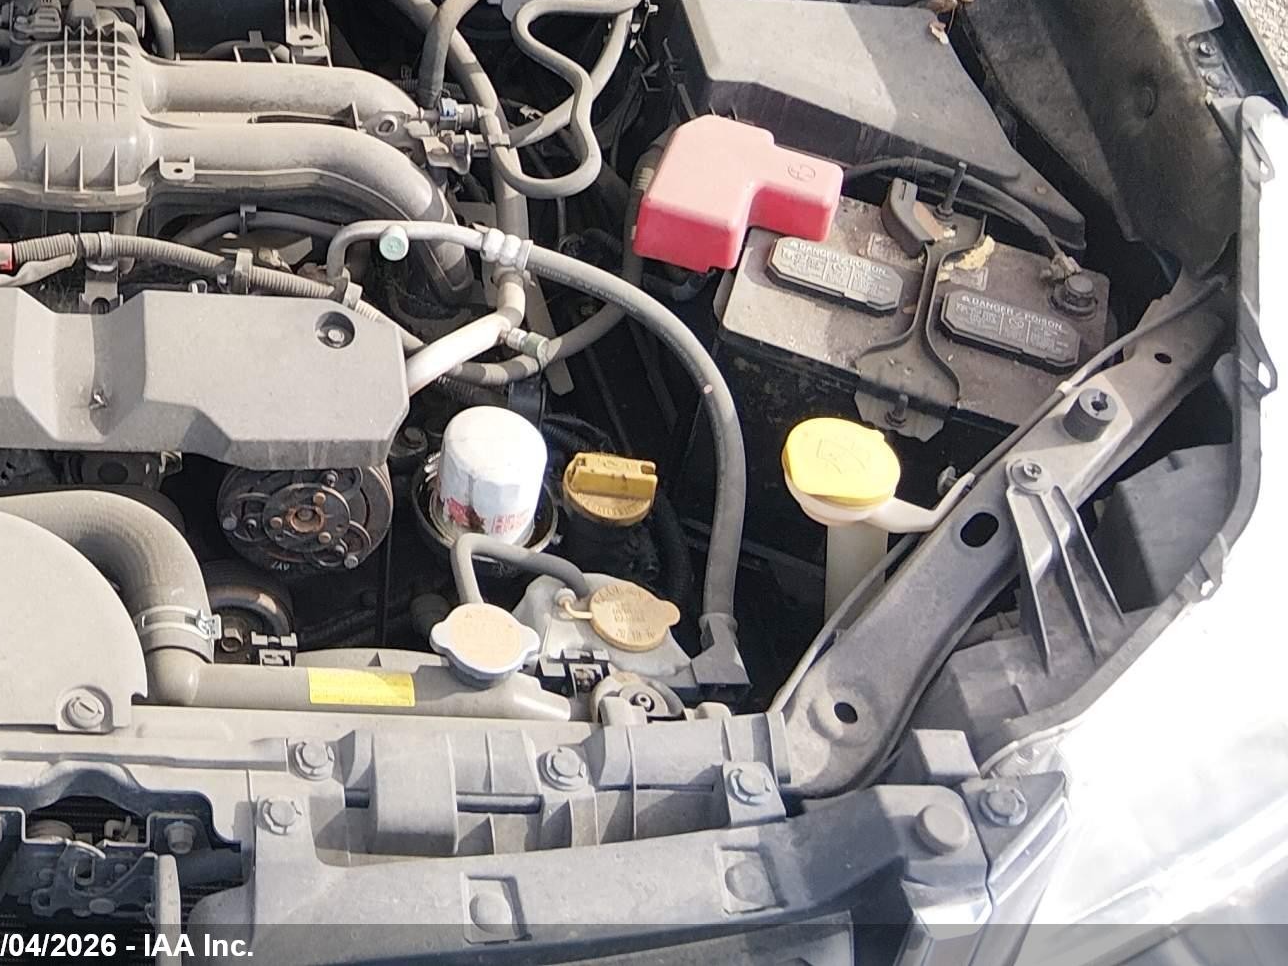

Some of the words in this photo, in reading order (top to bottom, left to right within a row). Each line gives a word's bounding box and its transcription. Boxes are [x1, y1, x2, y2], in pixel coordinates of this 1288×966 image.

[799, 242, 839, 261] DANGER
[850, 257, 886, 275] POISON
[972, 297, 1014, 315] DANGER
[1024, 313, 1063, 331] POISON
